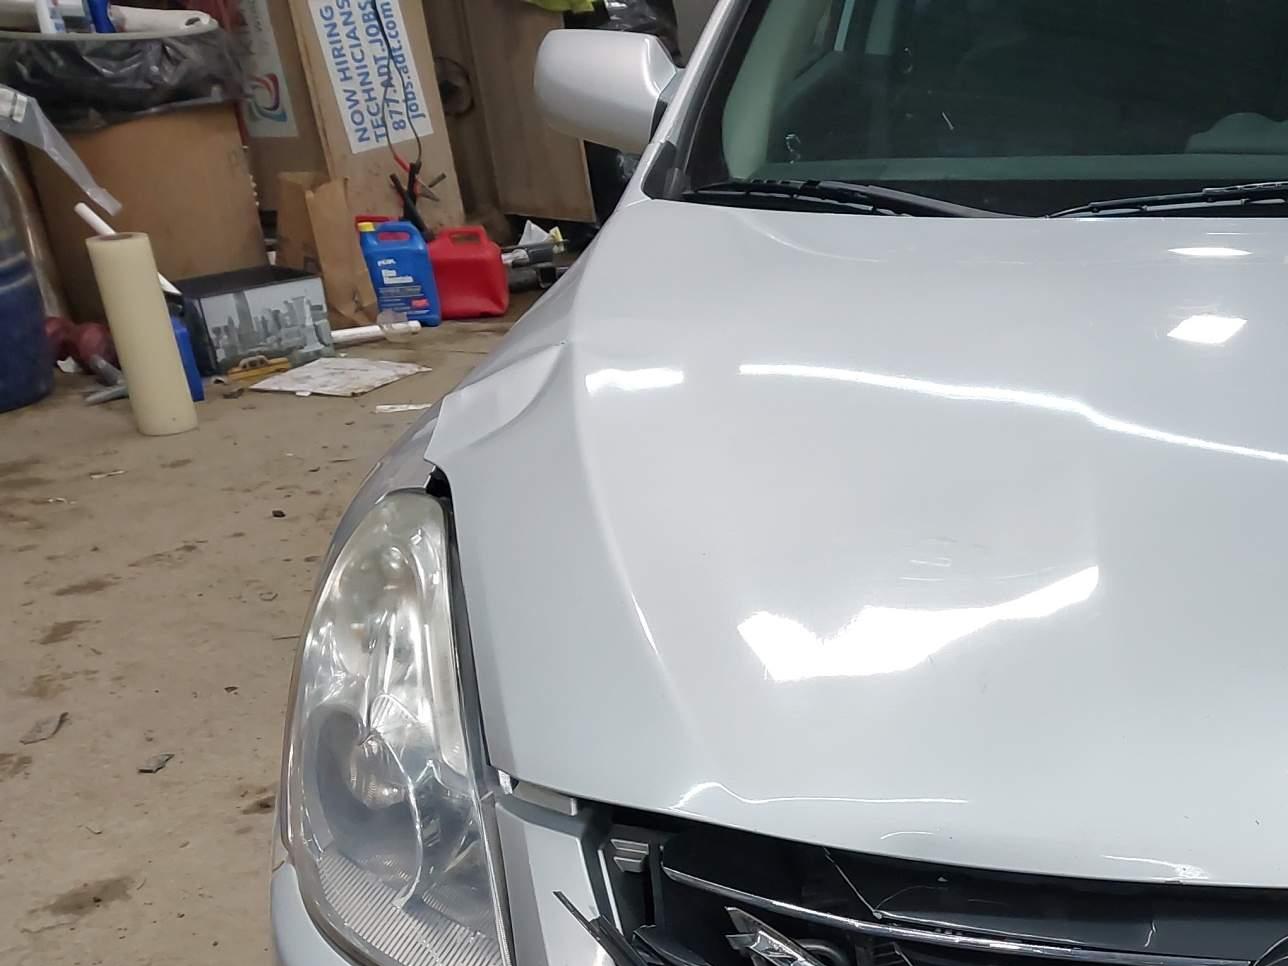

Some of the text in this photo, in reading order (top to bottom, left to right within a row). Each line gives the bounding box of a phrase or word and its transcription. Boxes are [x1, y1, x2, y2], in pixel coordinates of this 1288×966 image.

[320, 5, 370, 143] NOW HIRING
[336, 0, 387, 143] TECHNICIANS
